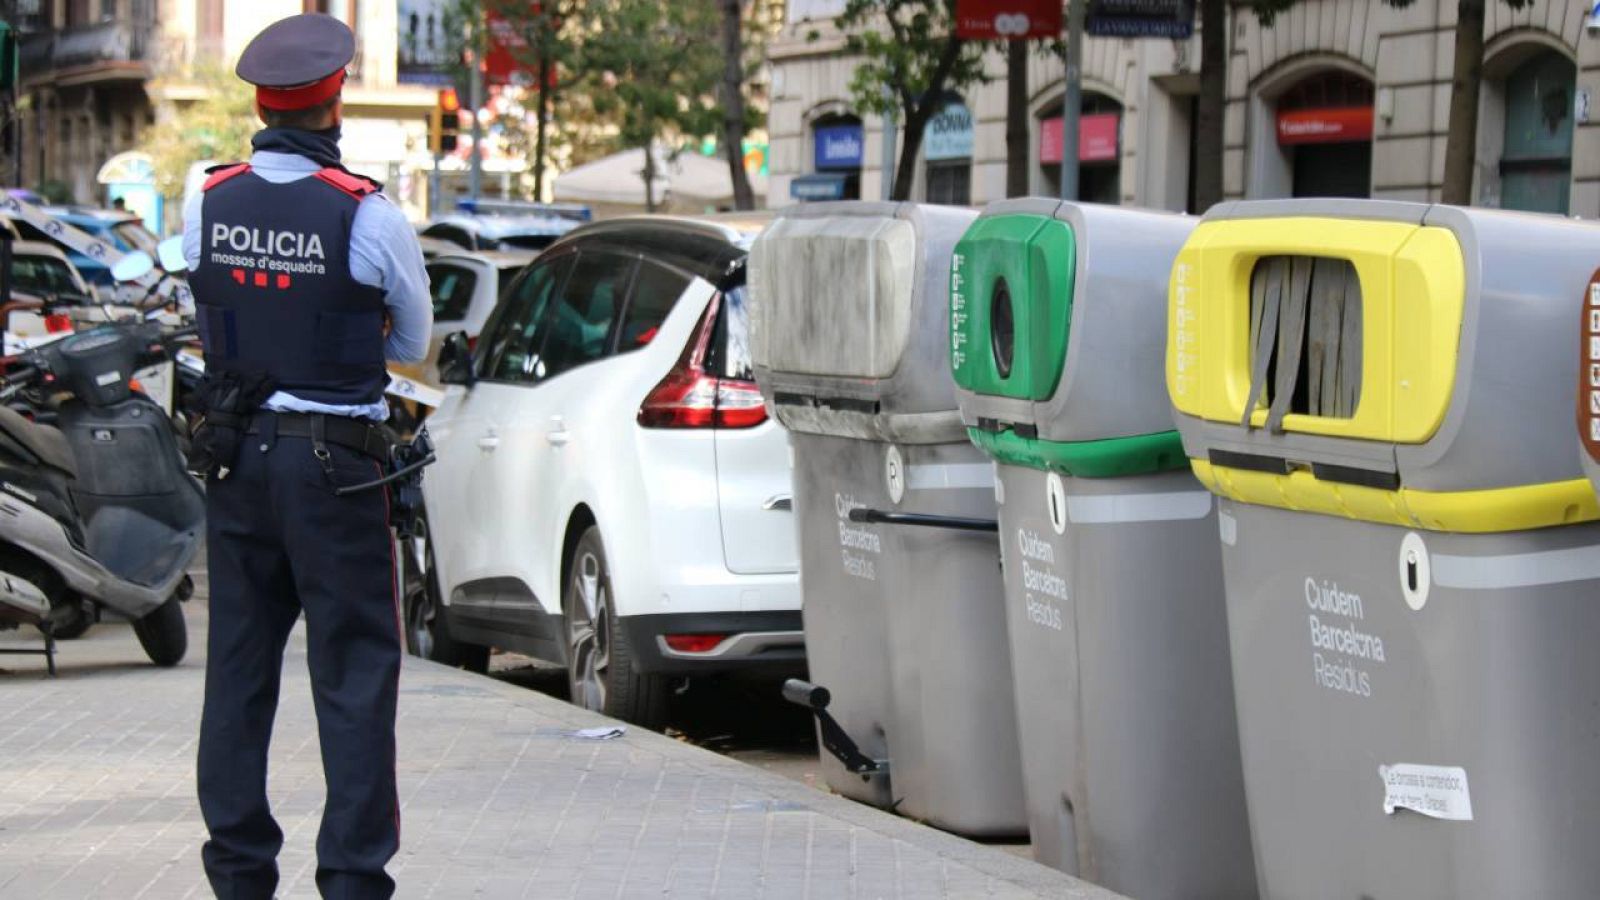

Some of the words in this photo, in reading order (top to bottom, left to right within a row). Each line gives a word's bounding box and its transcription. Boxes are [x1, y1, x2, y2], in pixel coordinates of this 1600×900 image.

[211, 223, 325, 259] POLICIA
[211, 252, 255, 268] mossos
[258, 256, 325, 275] d'esquadra
[1018, 527, 1055, 564] Cuidem
[1022, 558, 1068, 601] Barcelona
[1304, 576, 1364, 620] Cuidem
[1025, 591, 1062, 631] Residus
[1309, 613, 1386, 662] Barcelona
[1313, 651, 1371, 698] Residus
